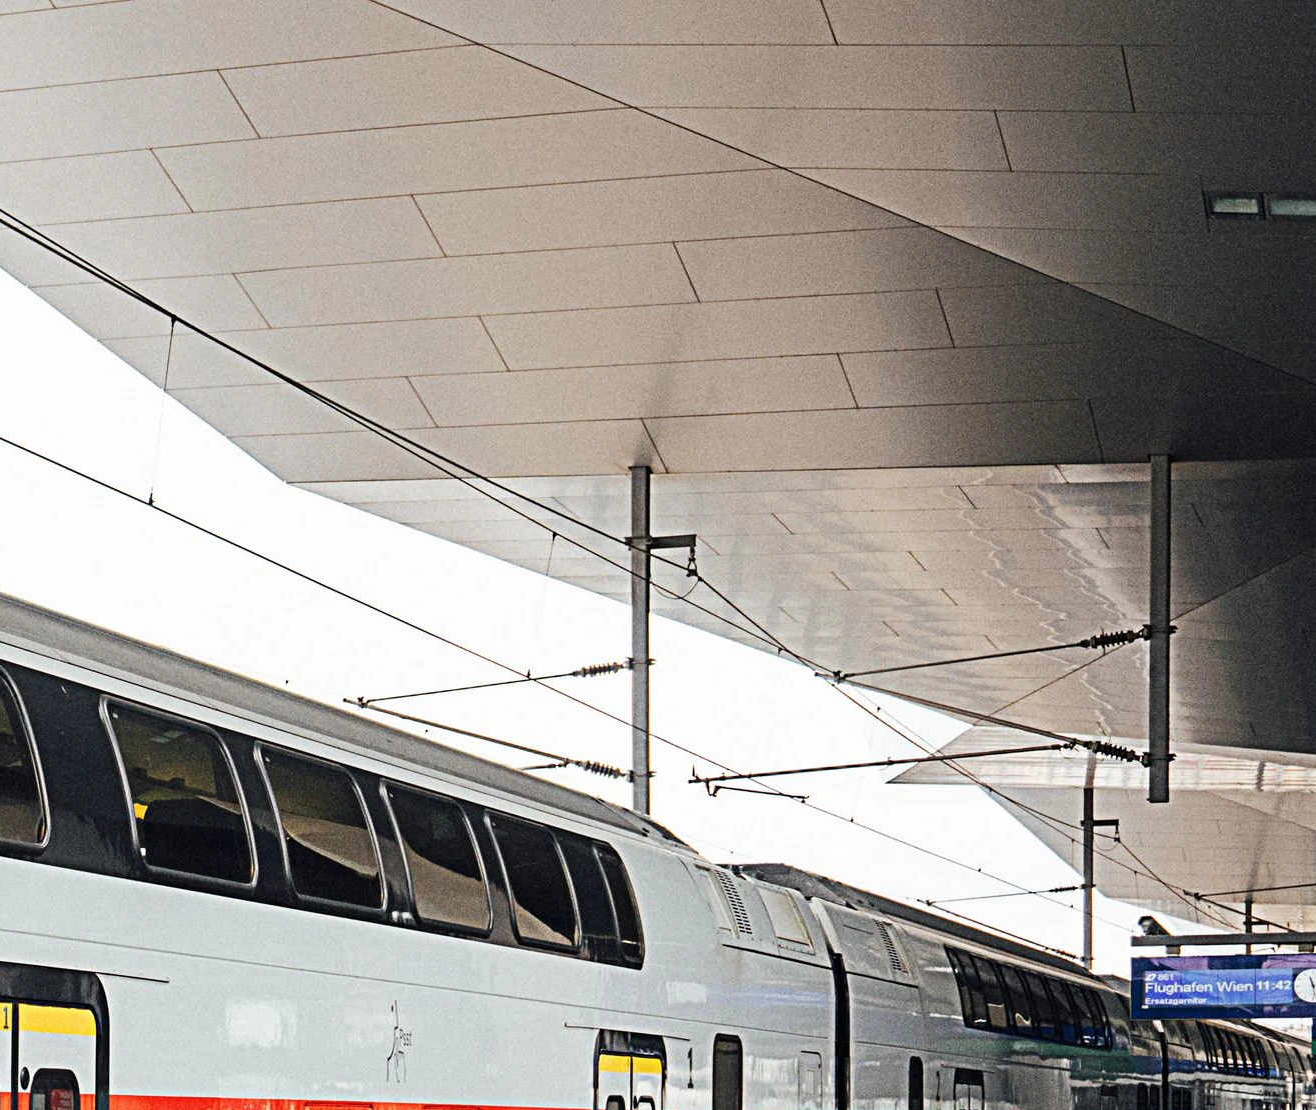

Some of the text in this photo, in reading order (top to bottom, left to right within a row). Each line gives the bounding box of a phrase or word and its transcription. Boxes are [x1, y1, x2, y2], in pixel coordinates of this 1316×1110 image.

[1145, 980, 1292, 995] Flughafen Wien 11:42
[1145, 997, 1207, 1006] Ersatzgarnitur
[3, 1006, 9, 1029] 1
[687, 1047, 694, 1089] 1
